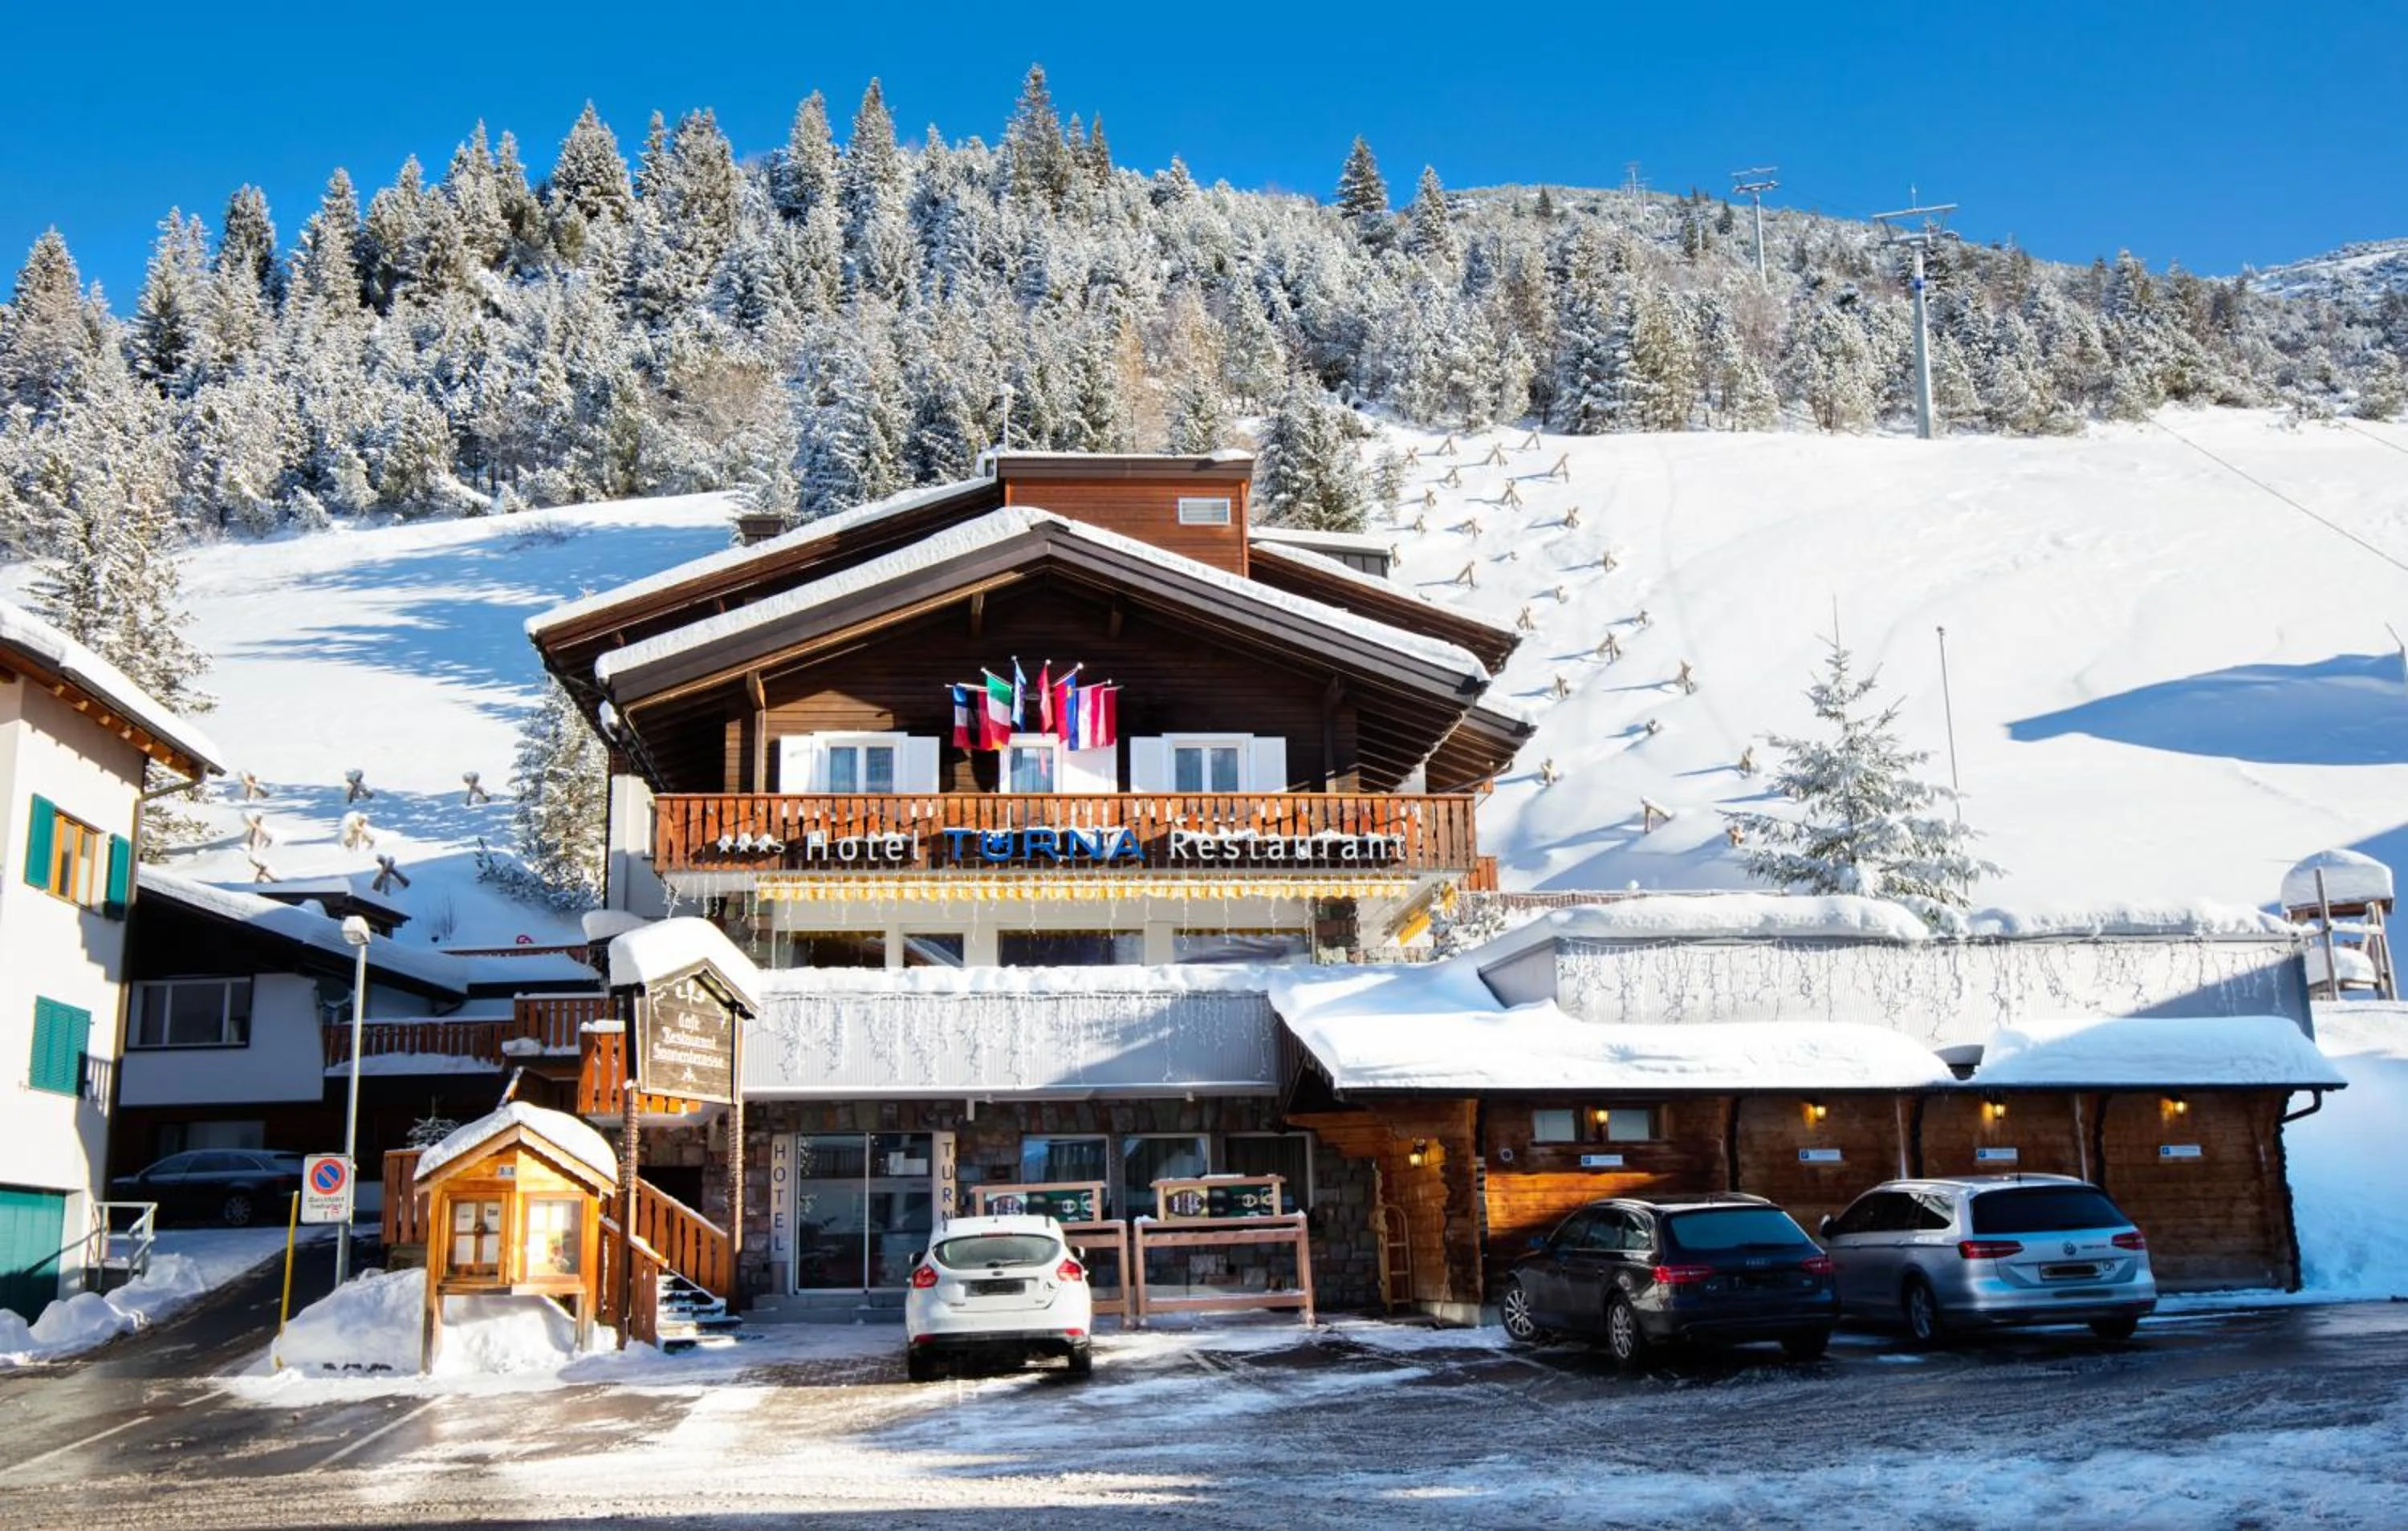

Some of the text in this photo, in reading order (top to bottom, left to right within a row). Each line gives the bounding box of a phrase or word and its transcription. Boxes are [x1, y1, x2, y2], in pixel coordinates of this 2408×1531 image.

[807, 829, 920, 861] Hotel
[942, 828, 1145, 862] TURNA
[1169, 830, 1406, 860] Restaurant
[773, 1142, 786, 1252] HOTEL
